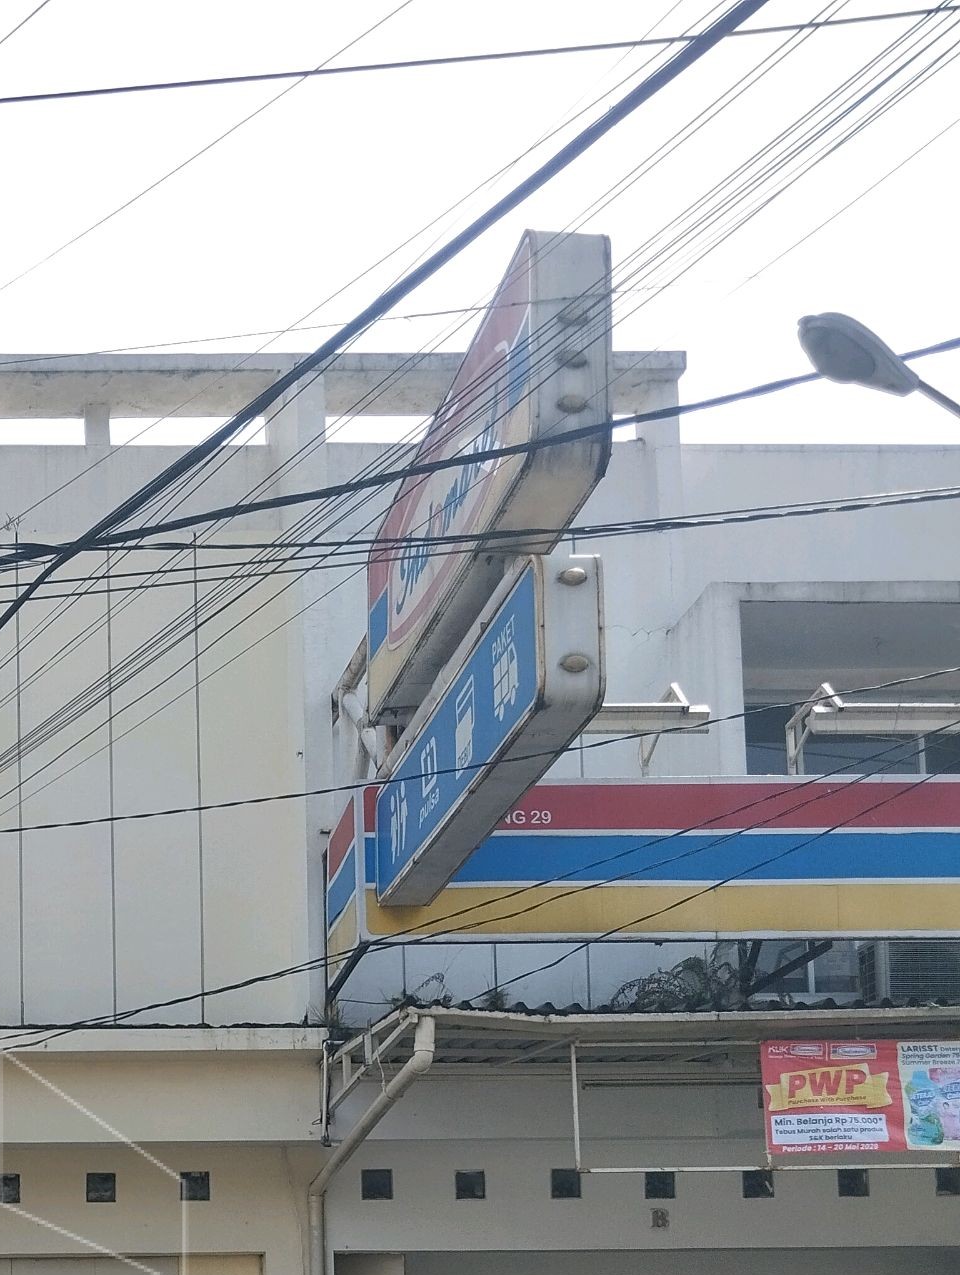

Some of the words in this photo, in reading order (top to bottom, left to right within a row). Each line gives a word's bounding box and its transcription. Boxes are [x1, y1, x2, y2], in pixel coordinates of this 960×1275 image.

[491, 613, 516, 663] PAKET
[418, 787, 440, 829] pulsa
[530, 810, 552, 824] 29
[901, 1044, 938, 1053] LARISST
[789, 1069, 868, 1098] PWP
[774, 1118, 794, 1126] Min.
[796, 1117, 833, 1127] Belanja
[835, 1117, 847, 1126] Rp
